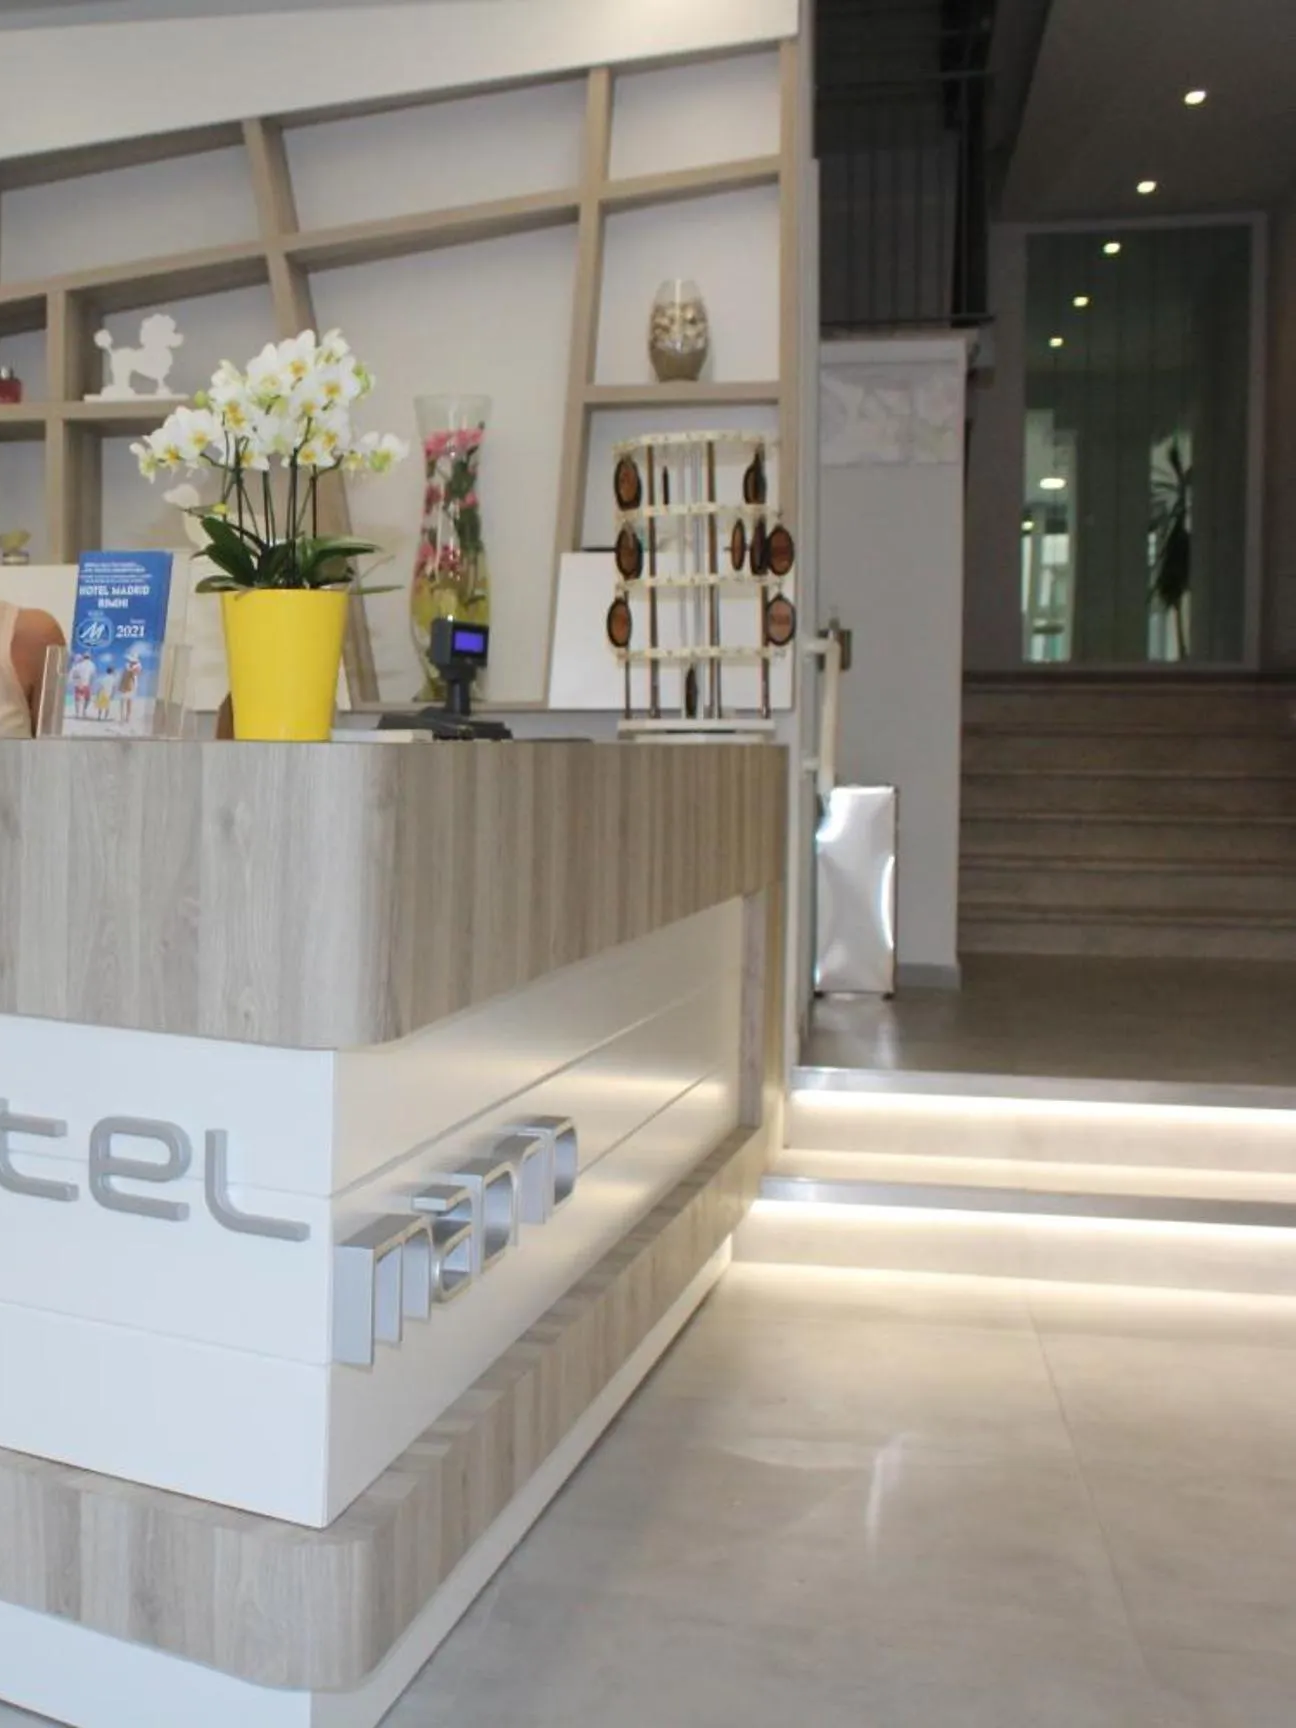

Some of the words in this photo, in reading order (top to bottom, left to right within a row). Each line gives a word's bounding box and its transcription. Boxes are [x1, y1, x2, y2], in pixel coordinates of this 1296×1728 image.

[79, 584, 109, 596] HOTEL
[111, 584, 150, 596] MADRID
[115, 624, 145, 639] 2021
